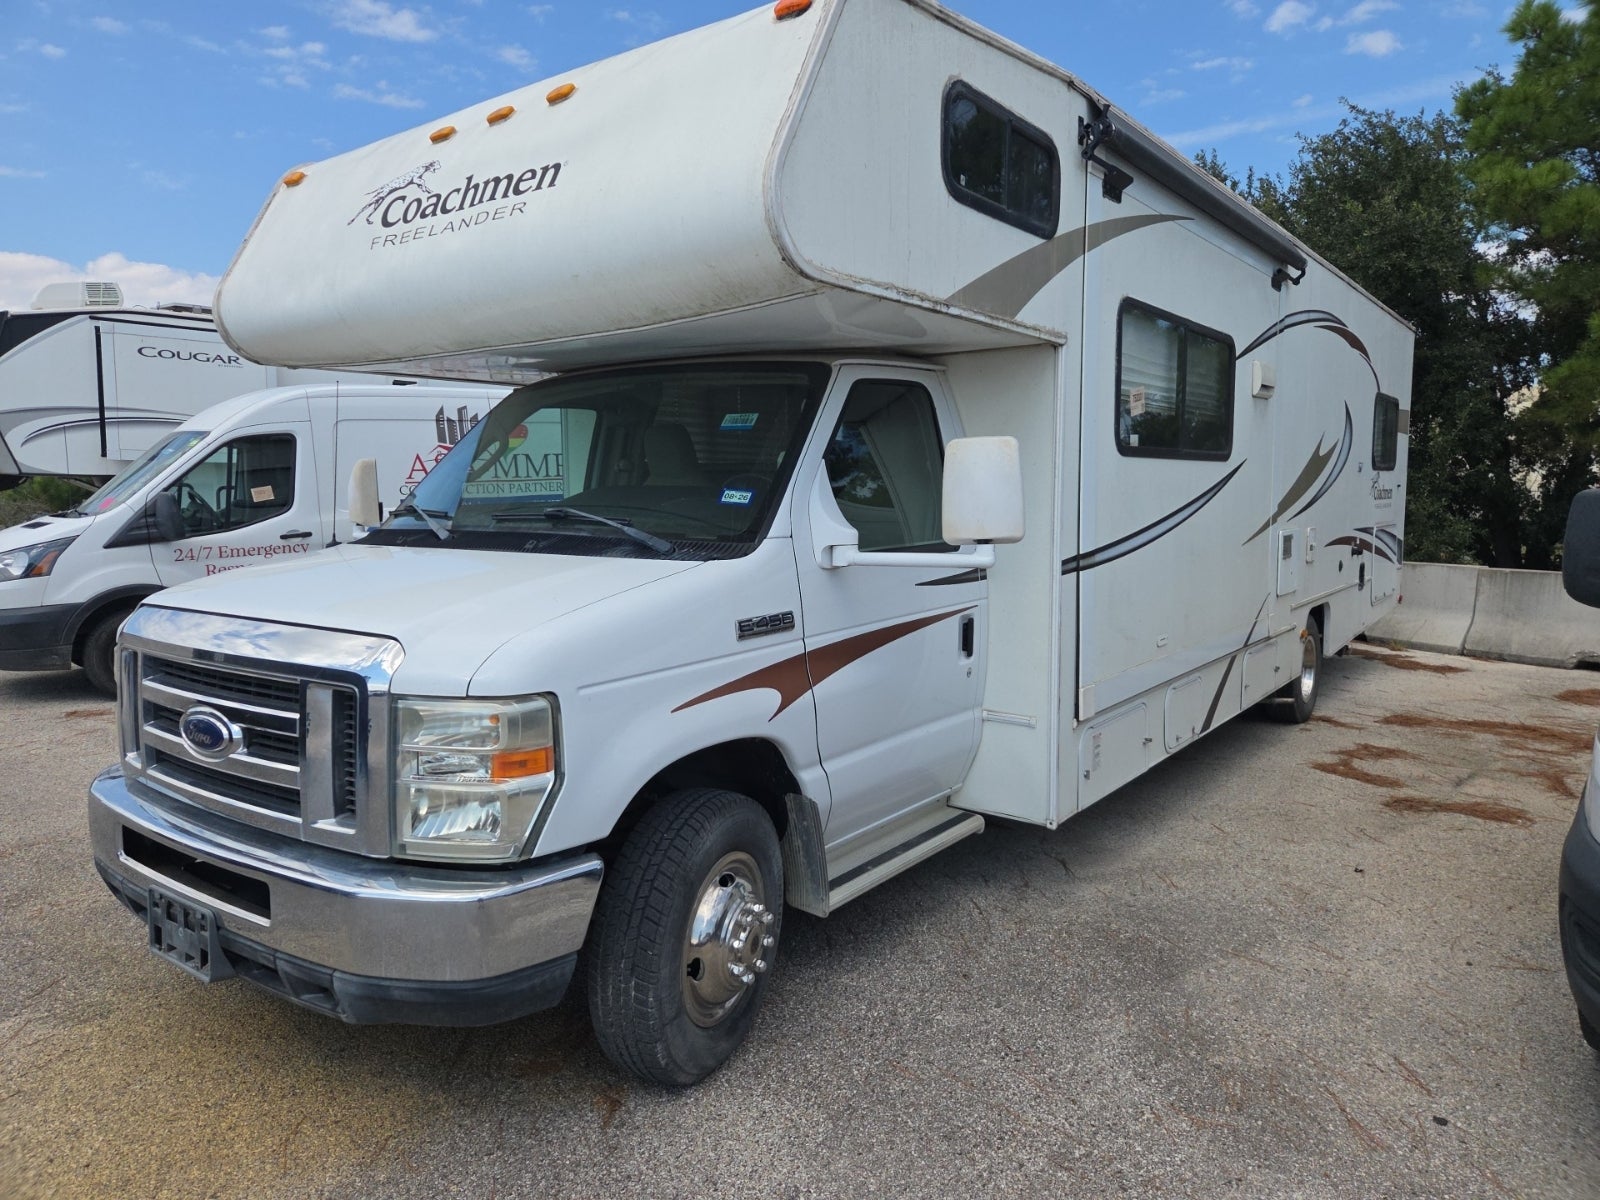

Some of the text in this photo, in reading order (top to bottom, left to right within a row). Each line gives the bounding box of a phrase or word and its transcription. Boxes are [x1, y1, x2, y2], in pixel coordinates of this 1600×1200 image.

[381, 161, 562, 228] Coachmen
[370, 201, 527, 250] FREELANDER
[137, 346, 243, 365] COUGAR
[174, 543, 310, 562] 24/7 Emergency
